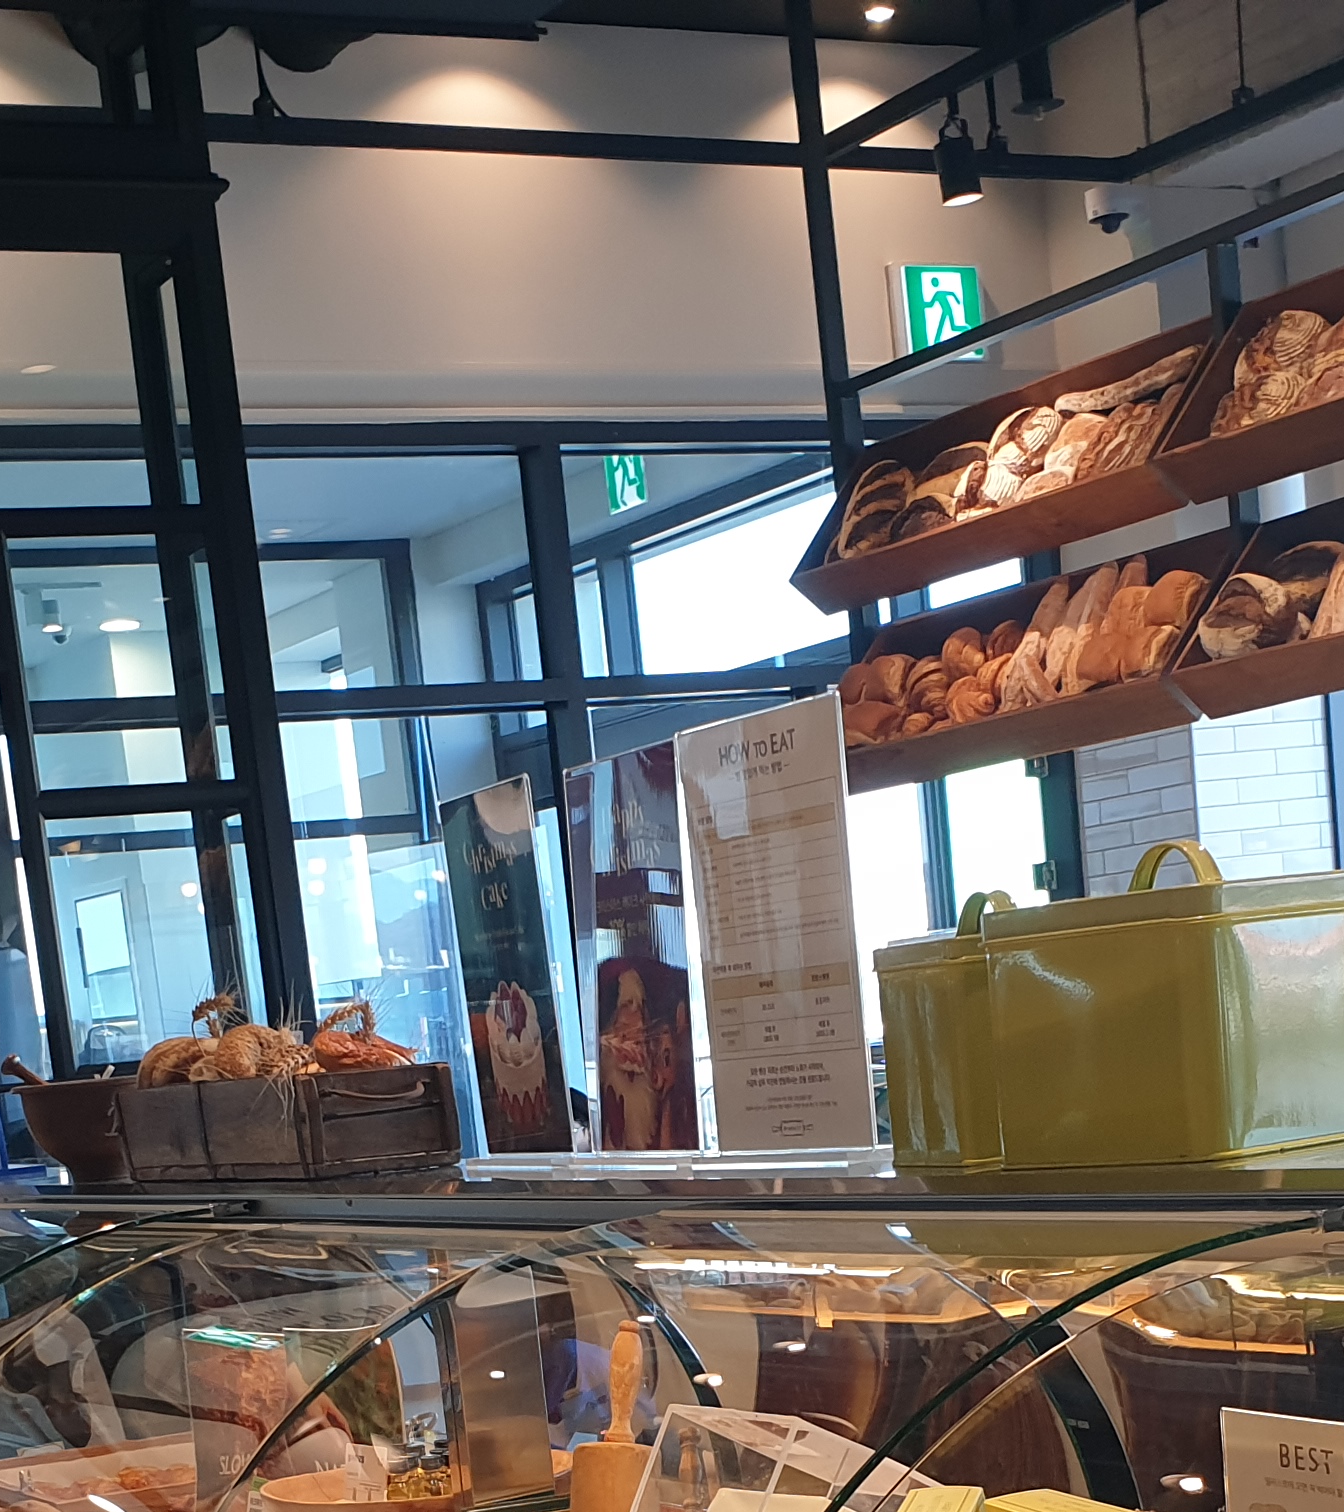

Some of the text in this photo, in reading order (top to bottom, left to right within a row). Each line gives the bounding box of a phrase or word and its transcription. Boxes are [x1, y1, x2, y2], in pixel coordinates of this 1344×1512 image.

[718, 740, 750, 767] HOW
[769, 727, 795, 755] EAT
[1278, 1442, 1334, 1475] BEST
